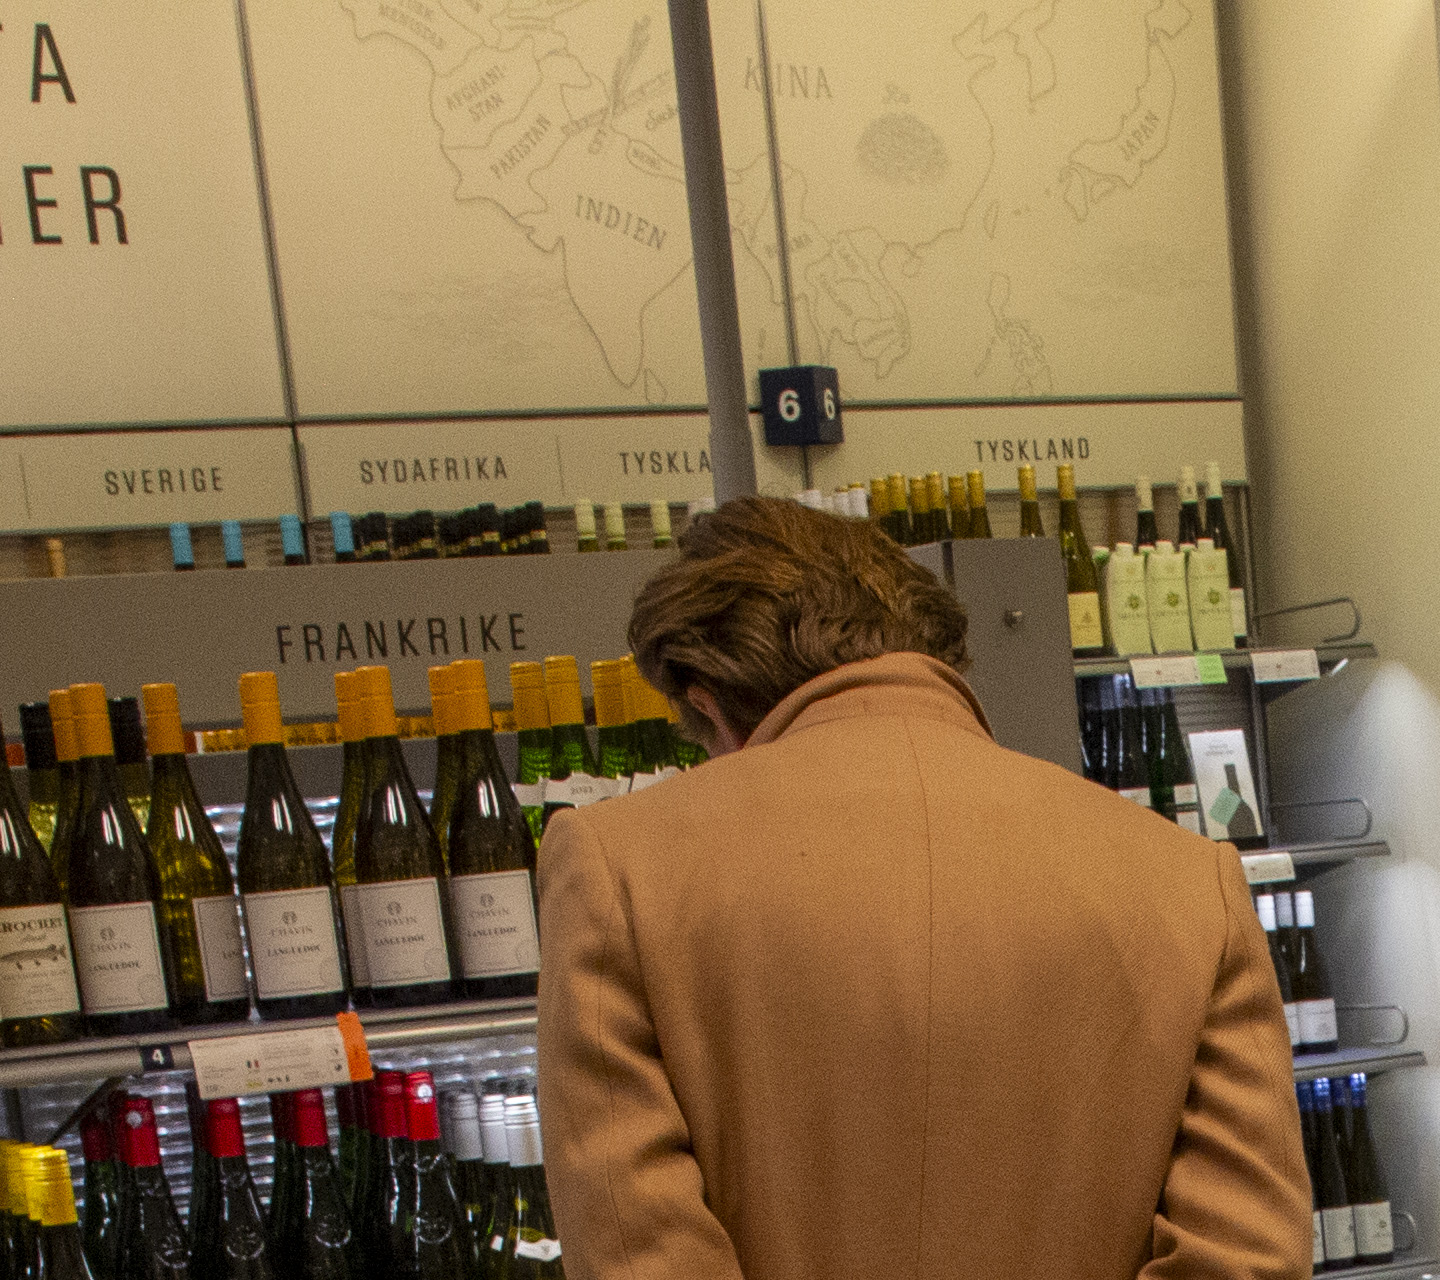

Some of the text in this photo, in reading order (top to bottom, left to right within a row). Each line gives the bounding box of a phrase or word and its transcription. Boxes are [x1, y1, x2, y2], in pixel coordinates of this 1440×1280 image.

[575, 194, 668, 251] INDIEN
[777, 389, 803, 422] 6
[823, 388, 836, 422] 6
[975, 437, 1091, 465] TYSKLAND
[104, 466, 224, 498] SVERIGE
[359, 454, 509, 486] SYDAFRIKA
[276, 612, 529, 665] FRANKRIKE
[150, 1048, 165, 1064] 4
